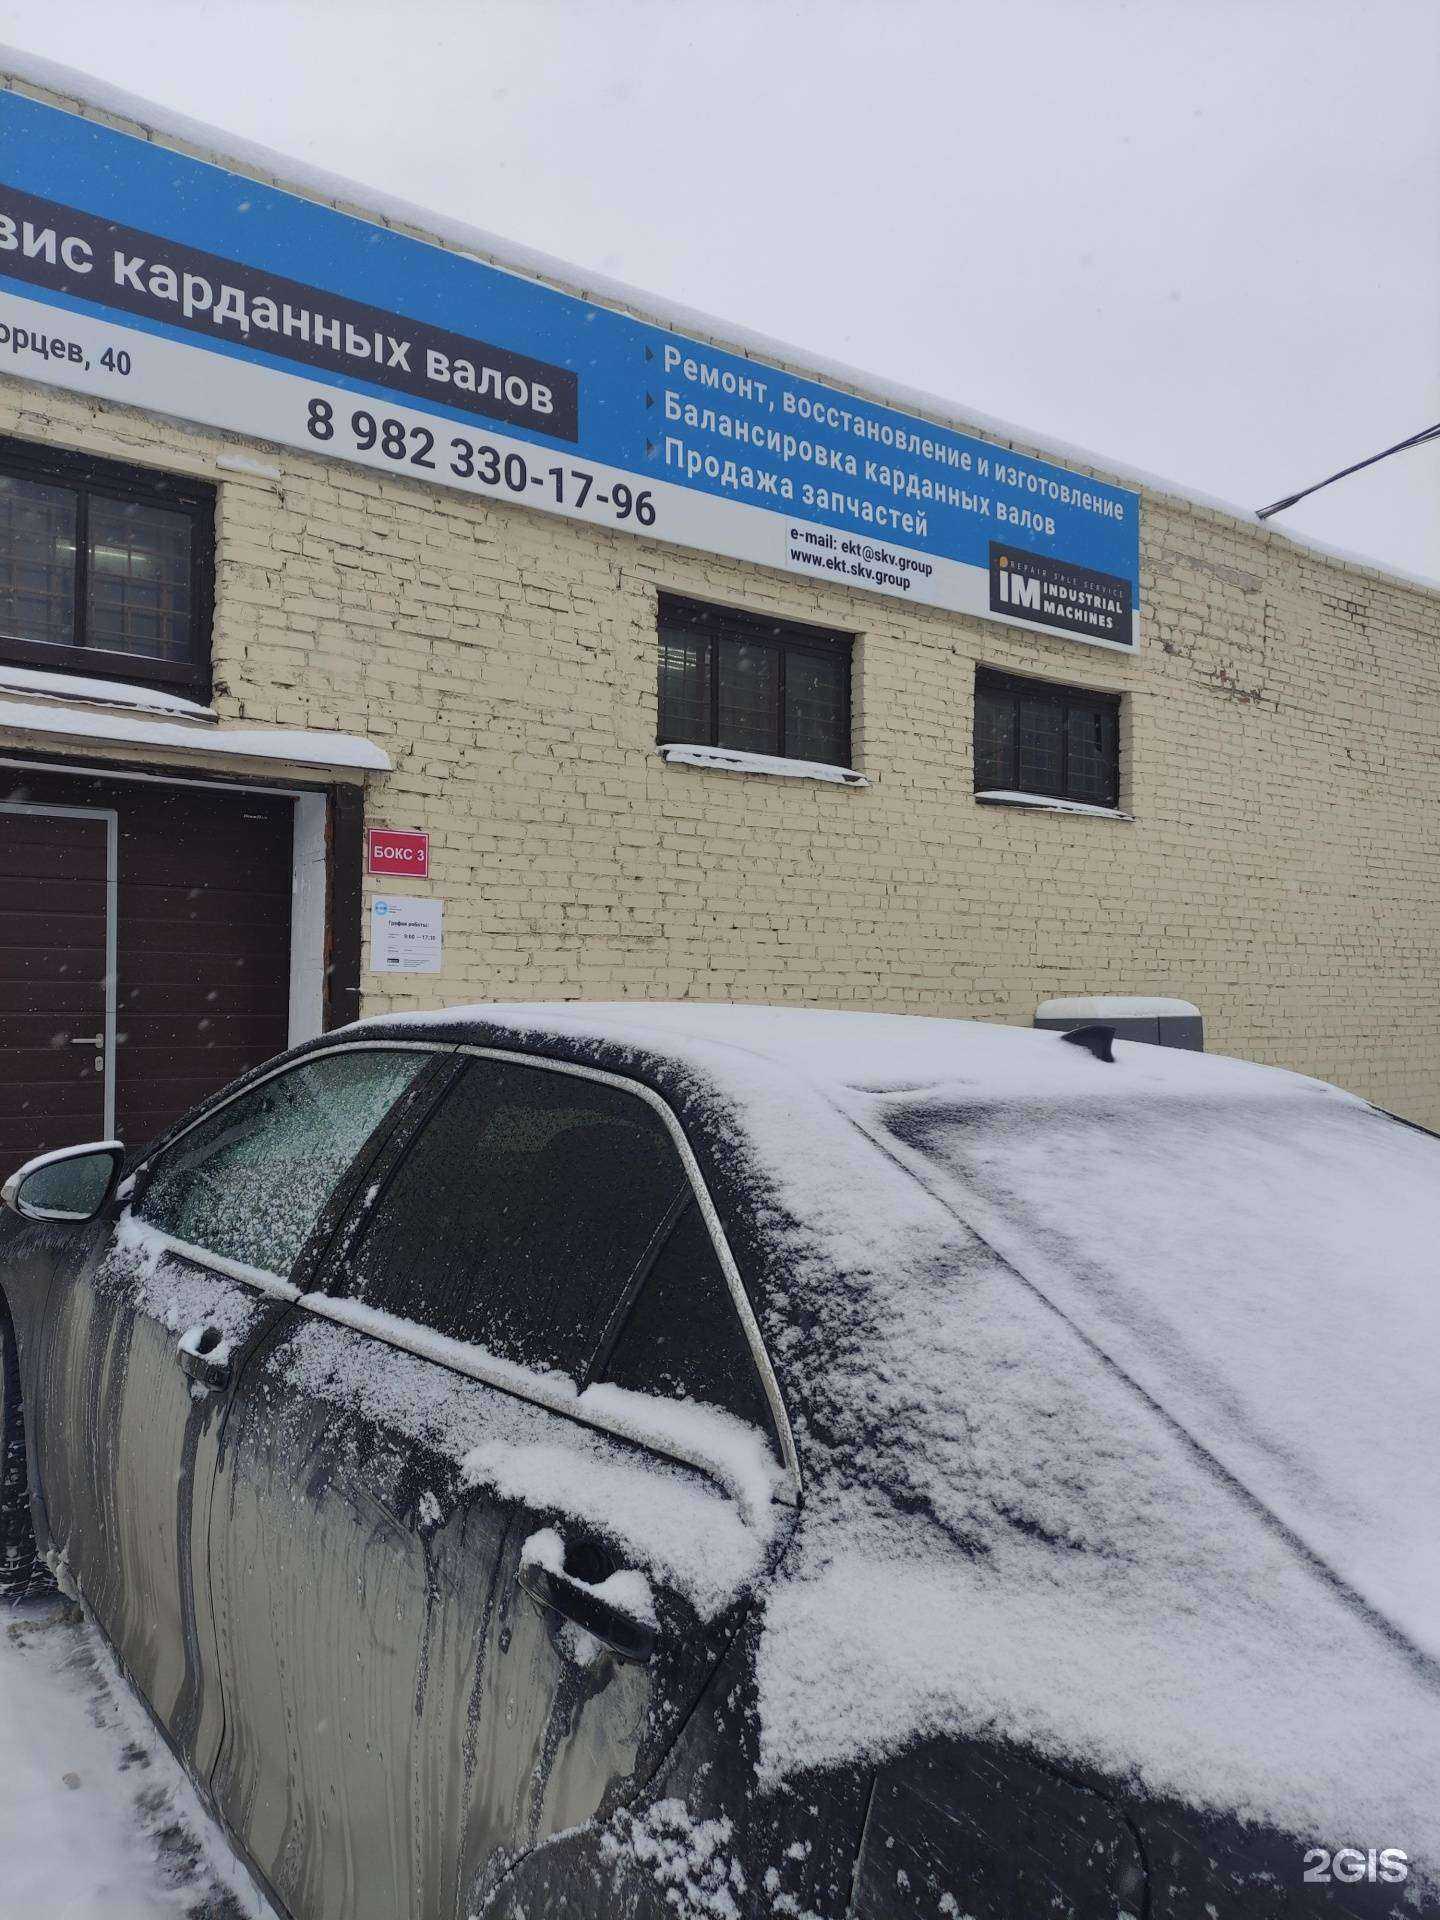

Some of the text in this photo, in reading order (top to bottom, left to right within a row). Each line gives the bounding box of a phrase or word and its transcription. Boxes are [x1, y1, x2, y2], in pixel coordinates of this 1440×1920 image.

[114, 251, 411, 373] карданных
[427, 349, 553, 414] валов
[100, 347, 131, 376] 40
[664, 344, 1124, 521] Ремонт, восстановление и изготовление
[307, 398, 656, 526] 8 982 330-17-96
[664, 390, 1055, 535] Балансировка карданных валов
[665, 436, 928, 537] Продажа запчастей
[790, 528, 933, 577] e-mail: ekt@skv.group
[790, 548, 911, 591] www.ekt.skv.group
[1044, 582, 1123, 614] INDUSTRIAL
[1044, 600, 1113, 629] MACHINES
[374, 846, 425, 861] БОКС 3
